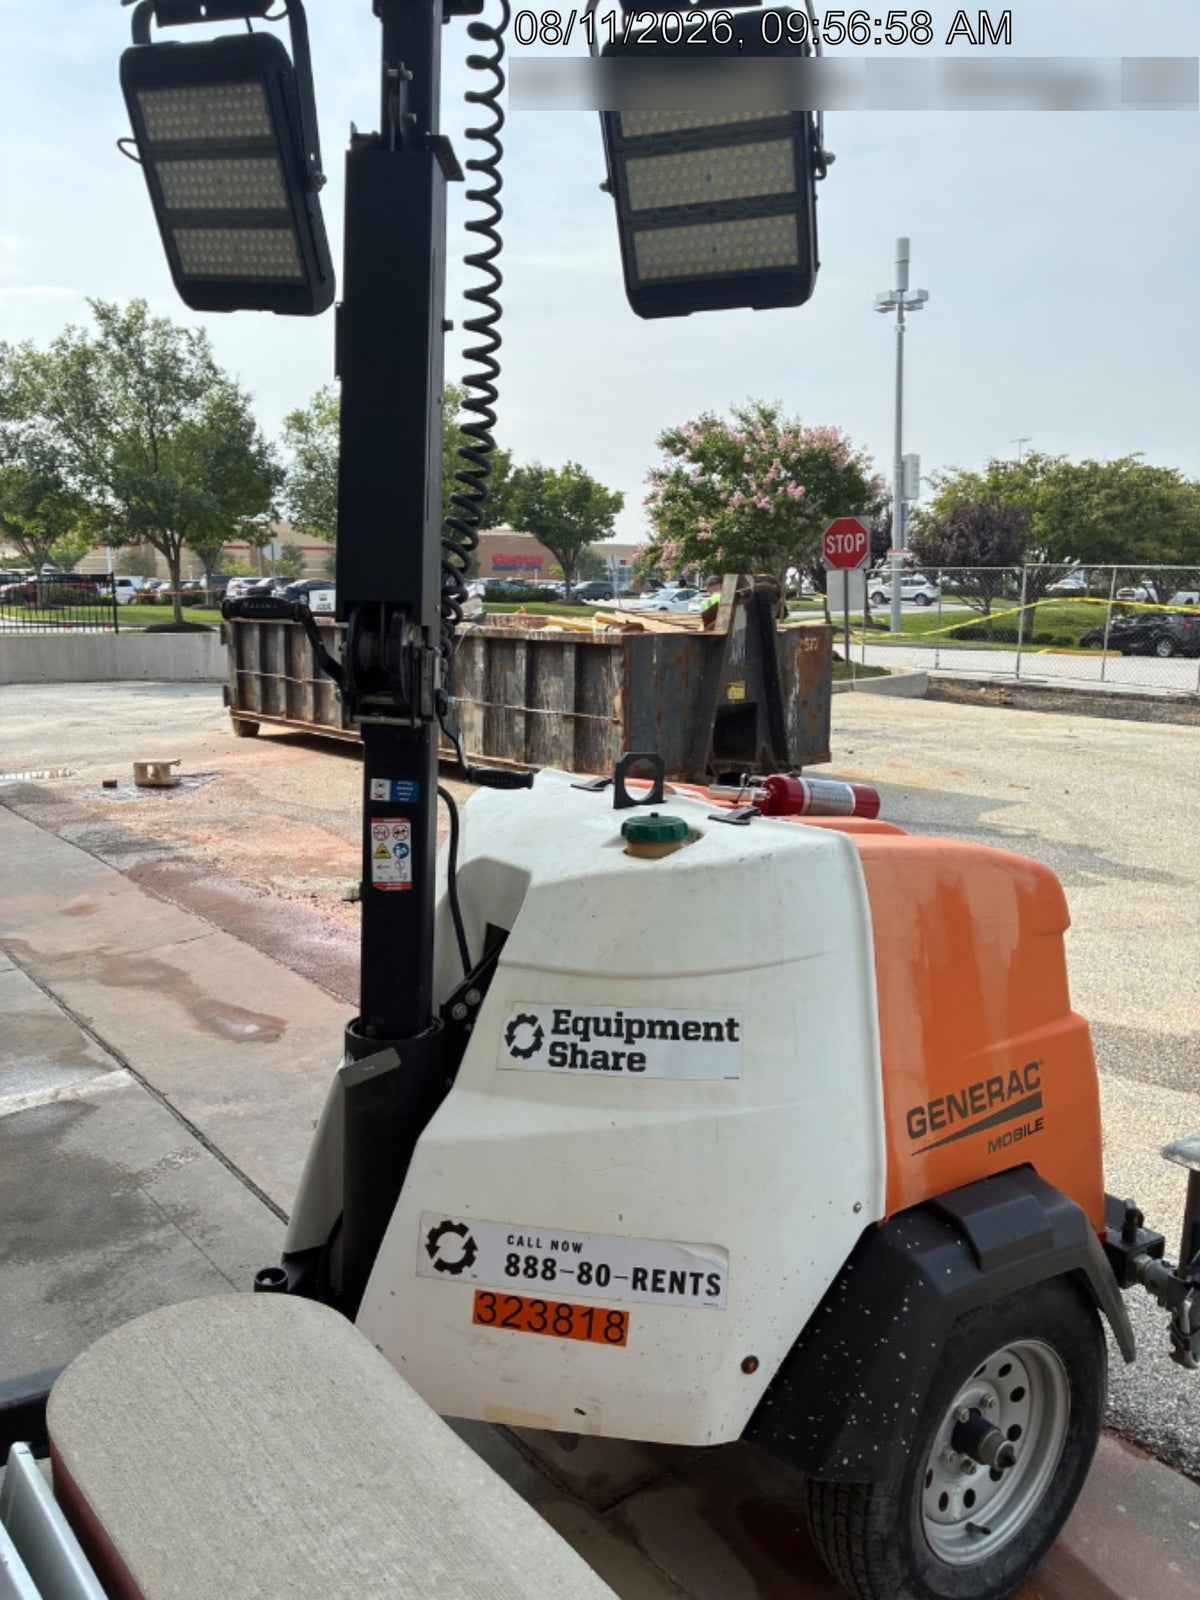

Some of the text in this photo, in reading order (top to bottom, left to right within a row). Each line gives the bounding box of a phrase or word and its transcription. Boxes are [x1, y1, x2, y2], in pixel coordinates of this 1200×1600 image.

[826, 533, 865, 554] STOP
[551, 1009, 740, 1045] Equipment
[548, 1041, 647, 1072] Share
[906, 1061, 1041, 1140] GENERAC
[988, 1117, 1044, 1154] MOBILE
[507, 1235, 583, 1253] CALL NOW
[476, 1292, 626, 1343] 323818
